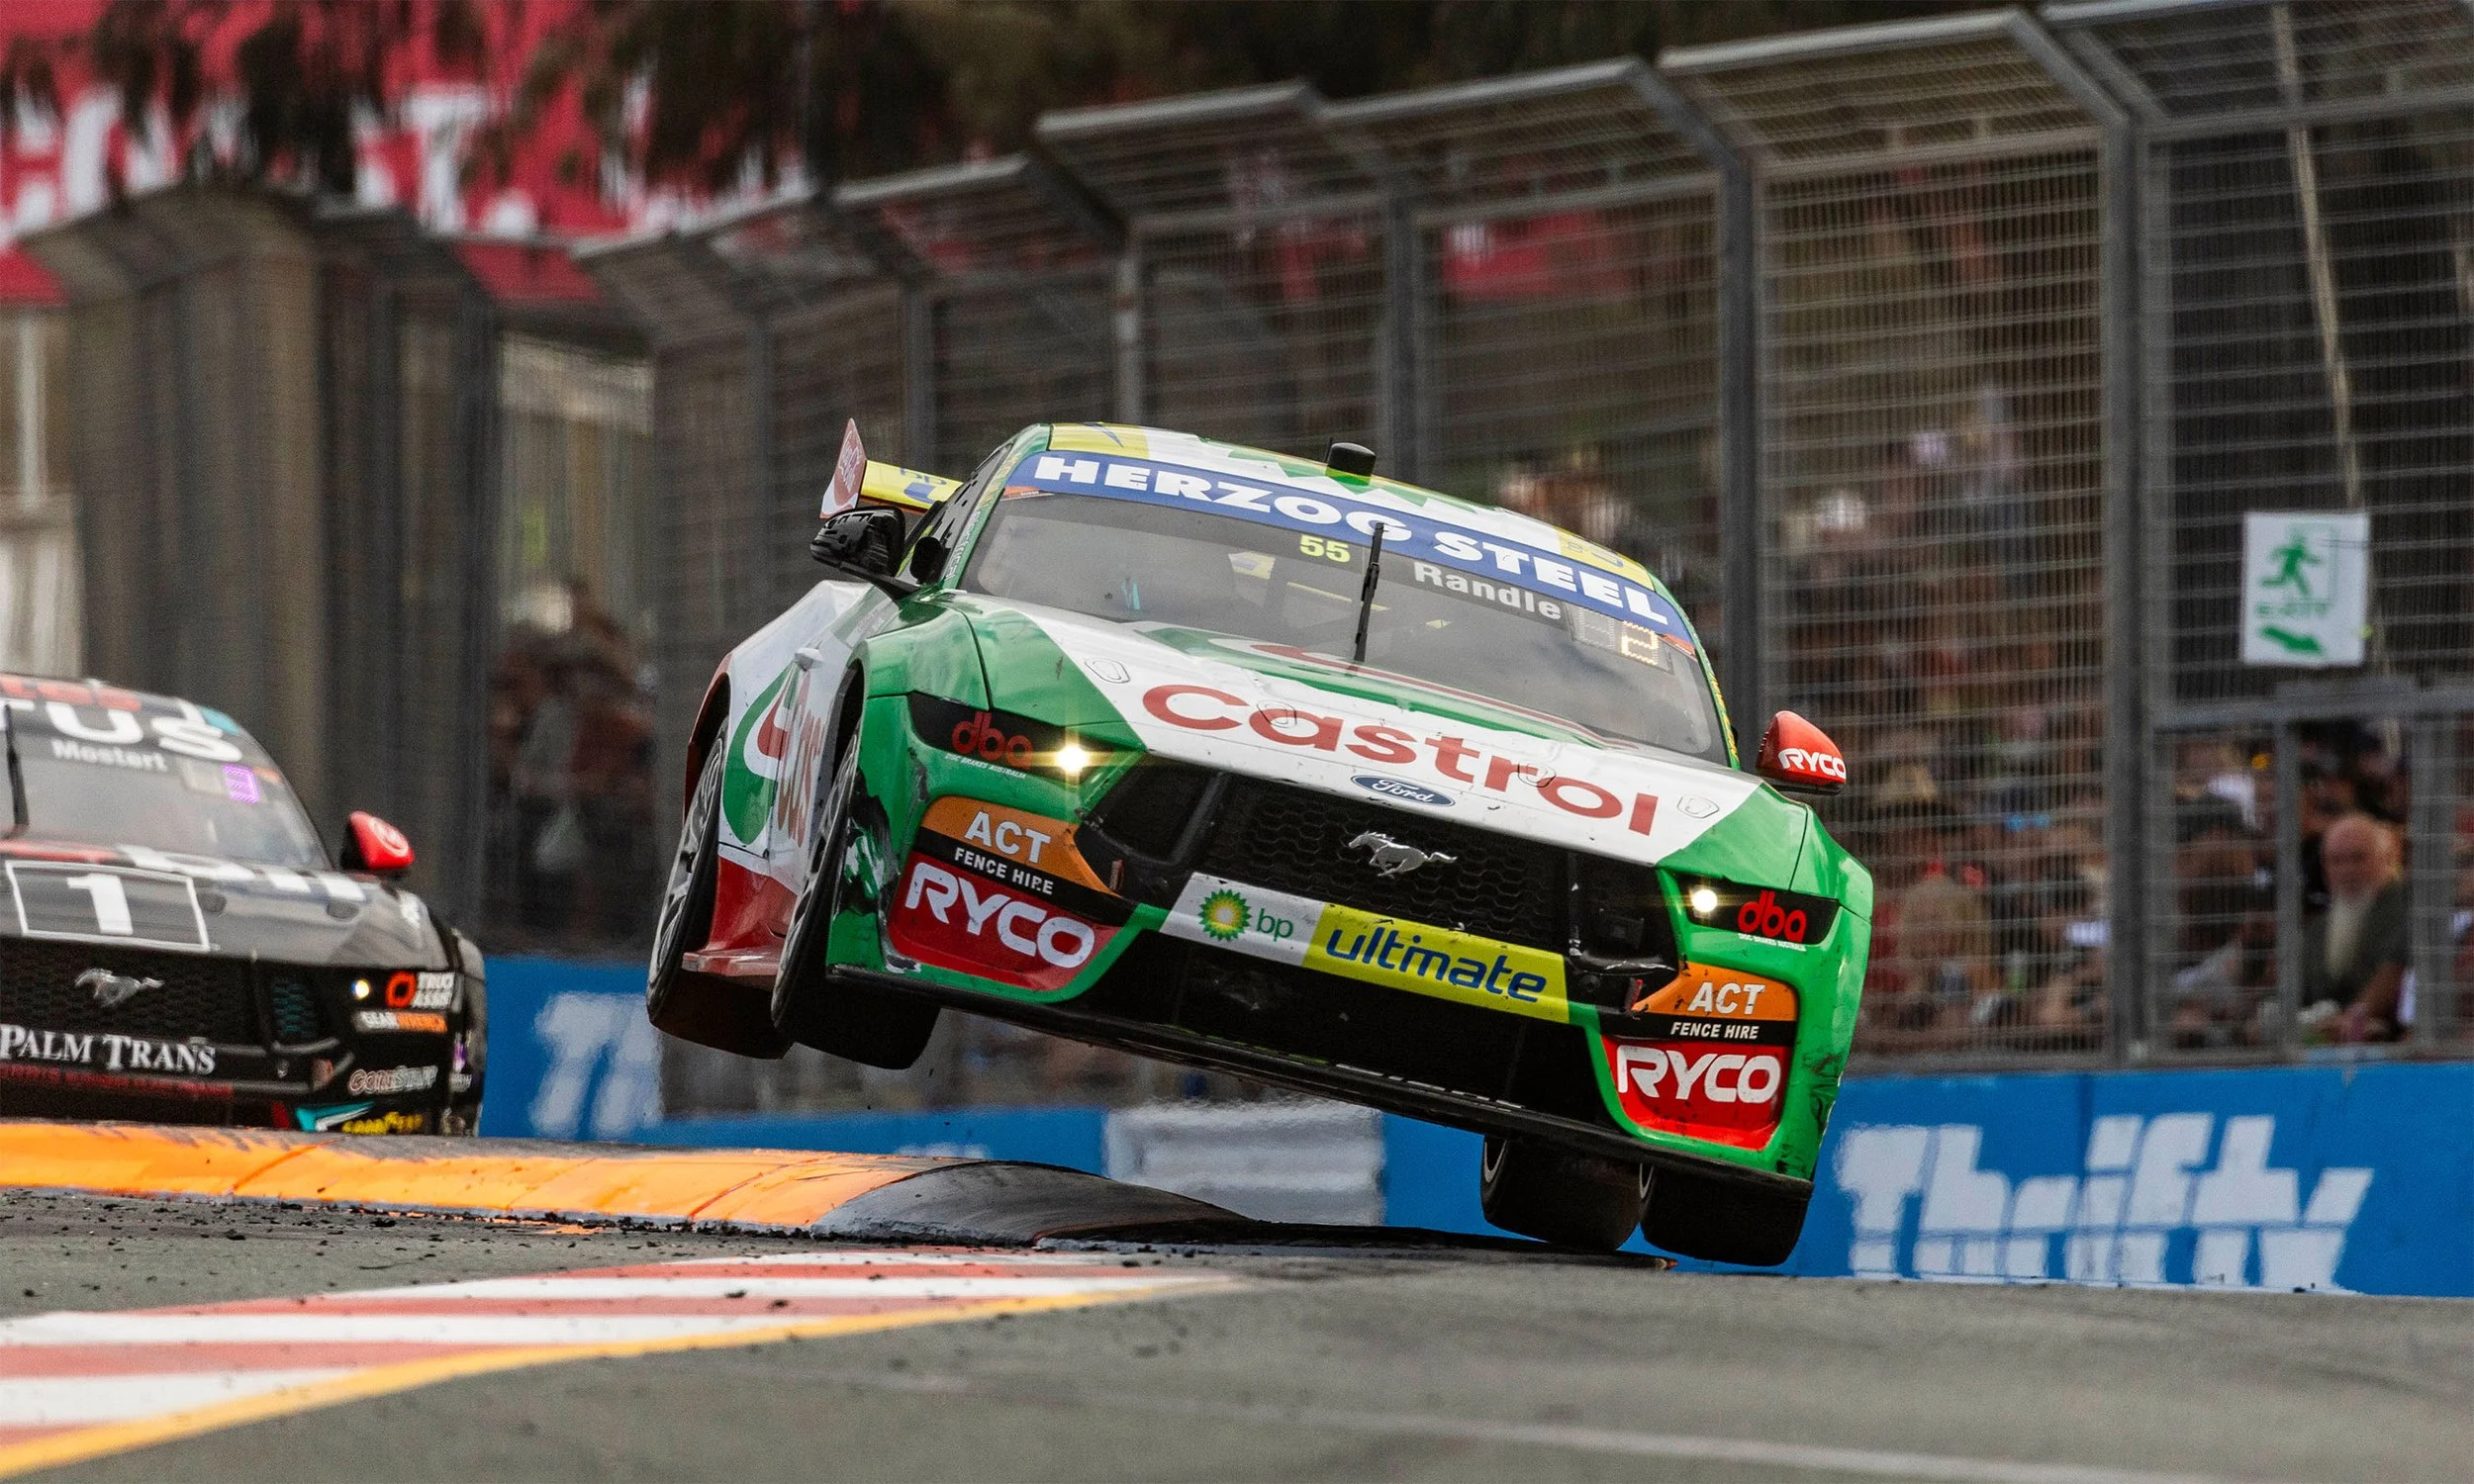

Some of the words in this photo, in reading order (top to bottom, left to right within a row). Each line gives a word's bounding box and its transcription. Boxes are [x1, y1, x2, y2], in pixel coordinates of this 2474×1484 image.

[1035, 456, 1411, 541] HERZOG
[1434, 532, 1667, 625] STEEL
[1299, 534, 1350, 563] 55
[1414, 562, 1561, 620] Randle
[1622, 620, 1658, 666] 2
[952, 711, 1032, 769] dba
[1143, 685, 1659, 836] Castrol
[1778, 748, 1848, 779] RYCO
[1372, 780, 1435, 802] Ford
[965, 811, 1051, 864] ACT
[955, 847, 1007, 881] FENCE
[1012, 868, 1054, 895] HIRE
[67, 874, 133, 935] 1
[904, 862, 1095, 969] RYCO
[1258, 908, 1293, 942] bp
[1738, 890, 1806, 942] dba
[1326, 928, 1546, 1003] ultimate
[1687, 981, 1766, 1014] ACT
[0, 1023, 93, 1064] PALM
[102, 1033, 216, 1075] TRANS
[1670, 1021, 1722, 1039] FENCE
[1725, 1024, 1759, 1041] HIRE
[1616, 1045, 1782, 1105] RYCO
[1835, 1112, 2374, 1290] Thrifty
